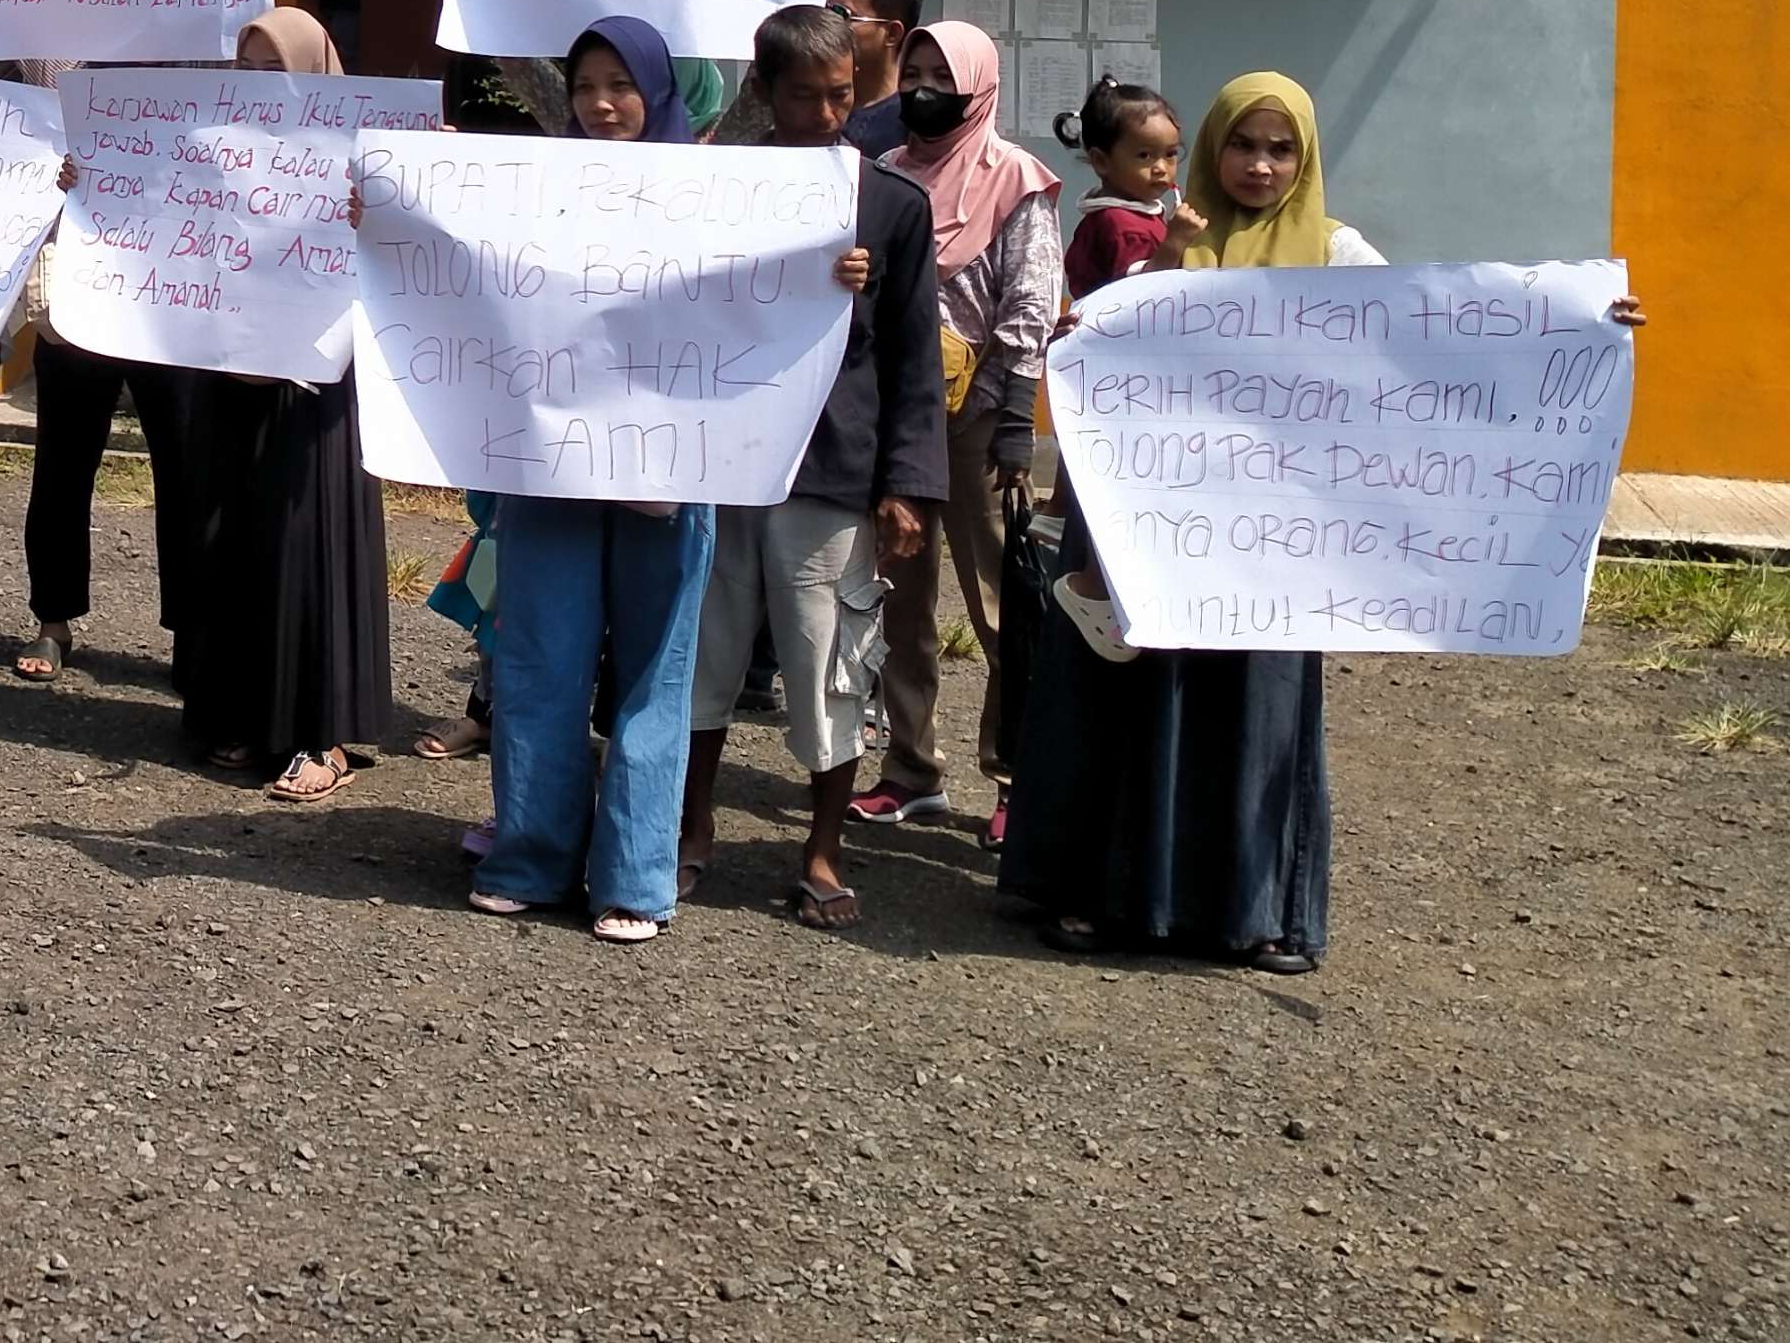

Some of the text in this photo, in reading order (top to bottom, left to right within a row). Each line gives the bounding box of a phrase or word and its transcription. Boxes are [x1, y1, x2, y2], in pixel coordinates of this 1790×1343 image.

[211, 82, 285, 128] Harus
[78, 165, 146, 207] Tanya
[377, 240, 547, 299] TOLONG
[606, 341, 781, 398] HAK
